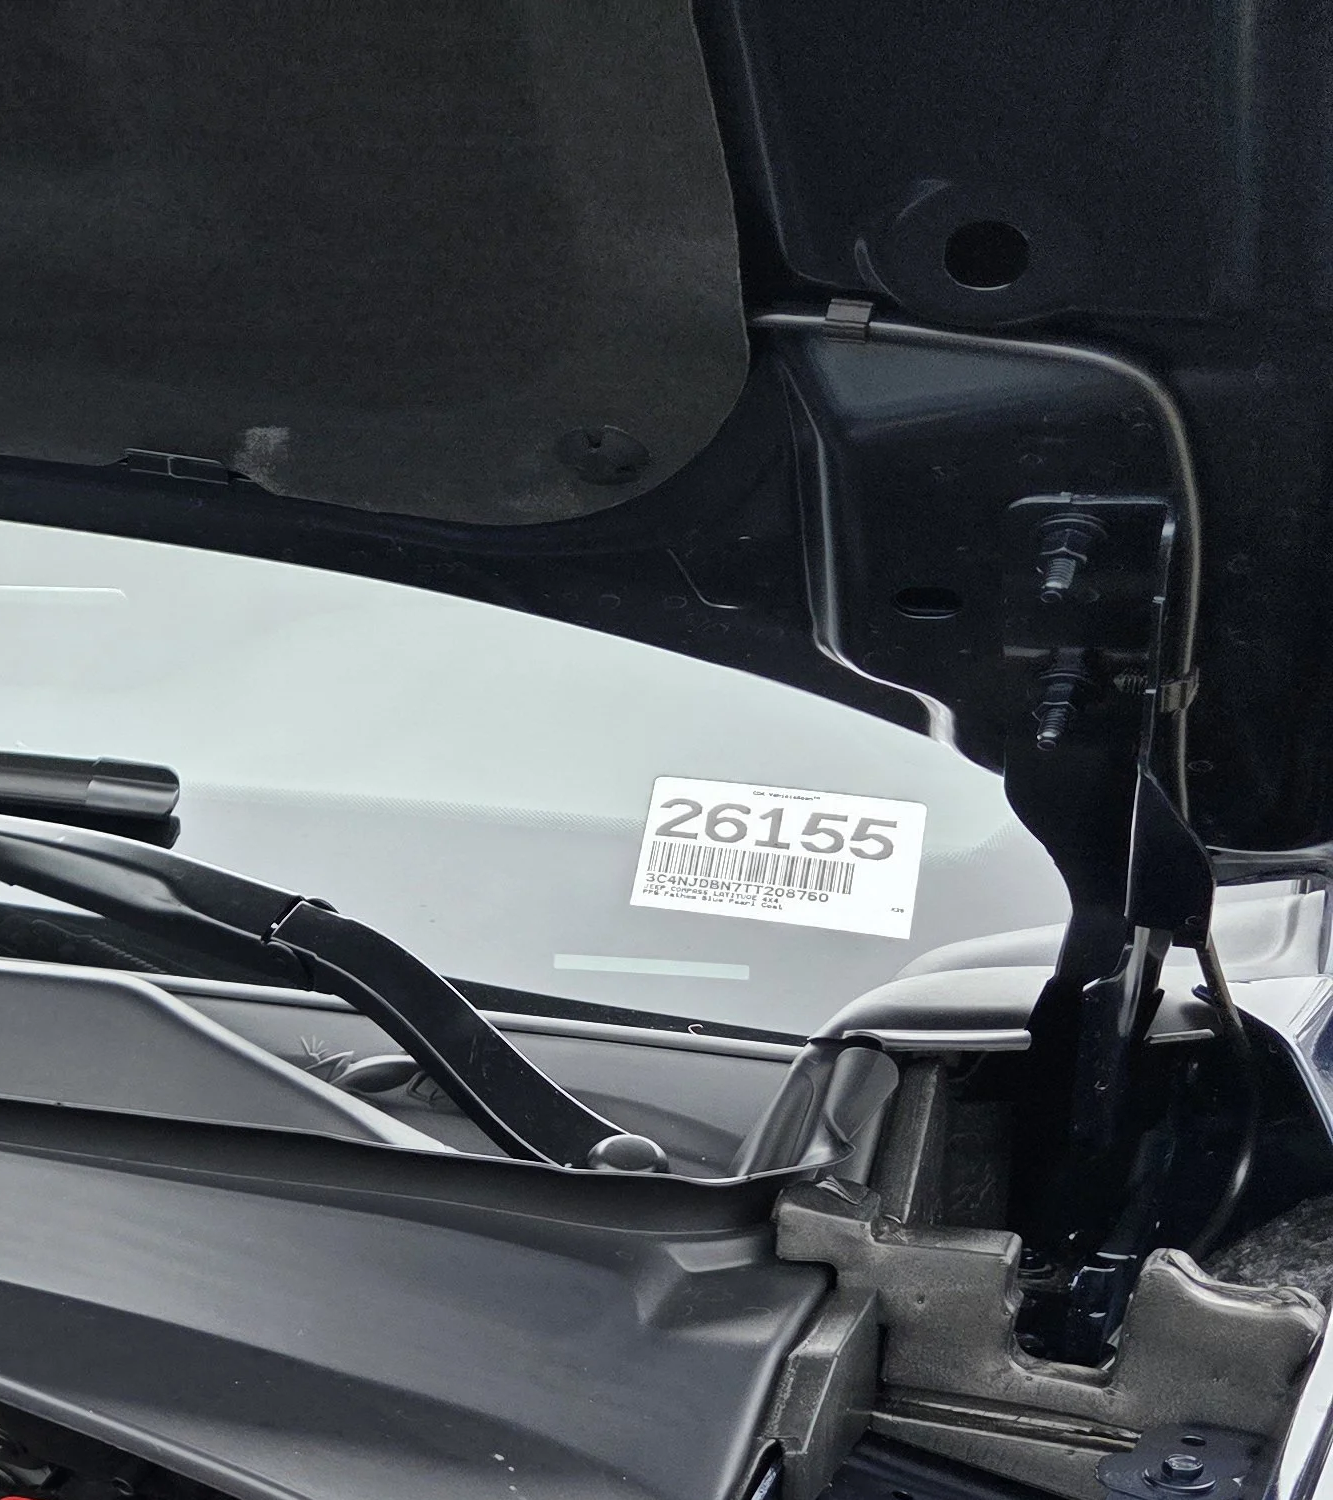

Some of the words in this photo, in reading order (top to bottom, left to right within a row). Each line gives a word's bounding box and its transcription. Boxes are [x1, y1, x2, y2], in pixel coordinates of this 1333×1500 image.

[654, 798, 898, 861] 26155
[645, 872, 830, 903] 3C4NJDBN7TT208760
[670, 886, 709, 896] COMPASS
[712, 891, 758, 901] LATITUDE
